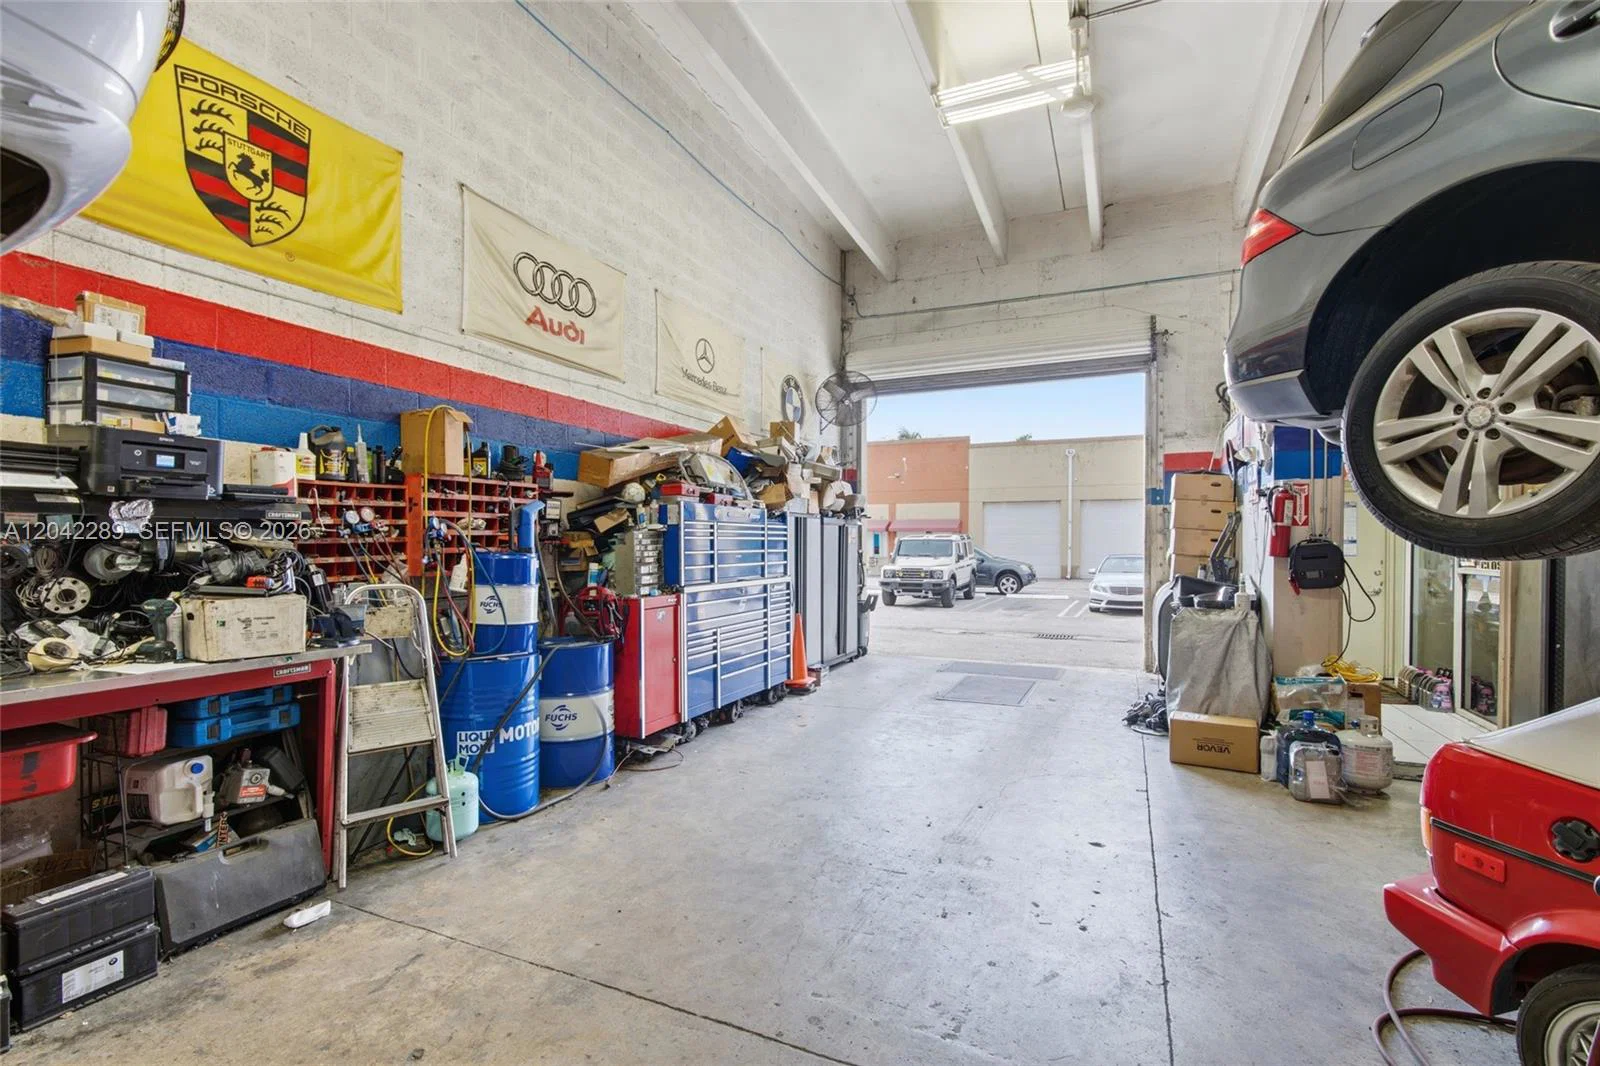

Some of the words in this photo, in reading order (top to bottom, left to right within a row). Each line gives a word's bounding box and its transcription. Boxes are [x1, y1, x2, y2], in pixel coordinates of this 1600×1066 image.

[180, 71, 306, 139] PORSCHE
[227, 137, 270, 160] STUTTGART
[524, 305, 585, 345] Audi
[545, 713, 578, 722] FUCHS
[1197, 744, 1231, 754] VEVOR
